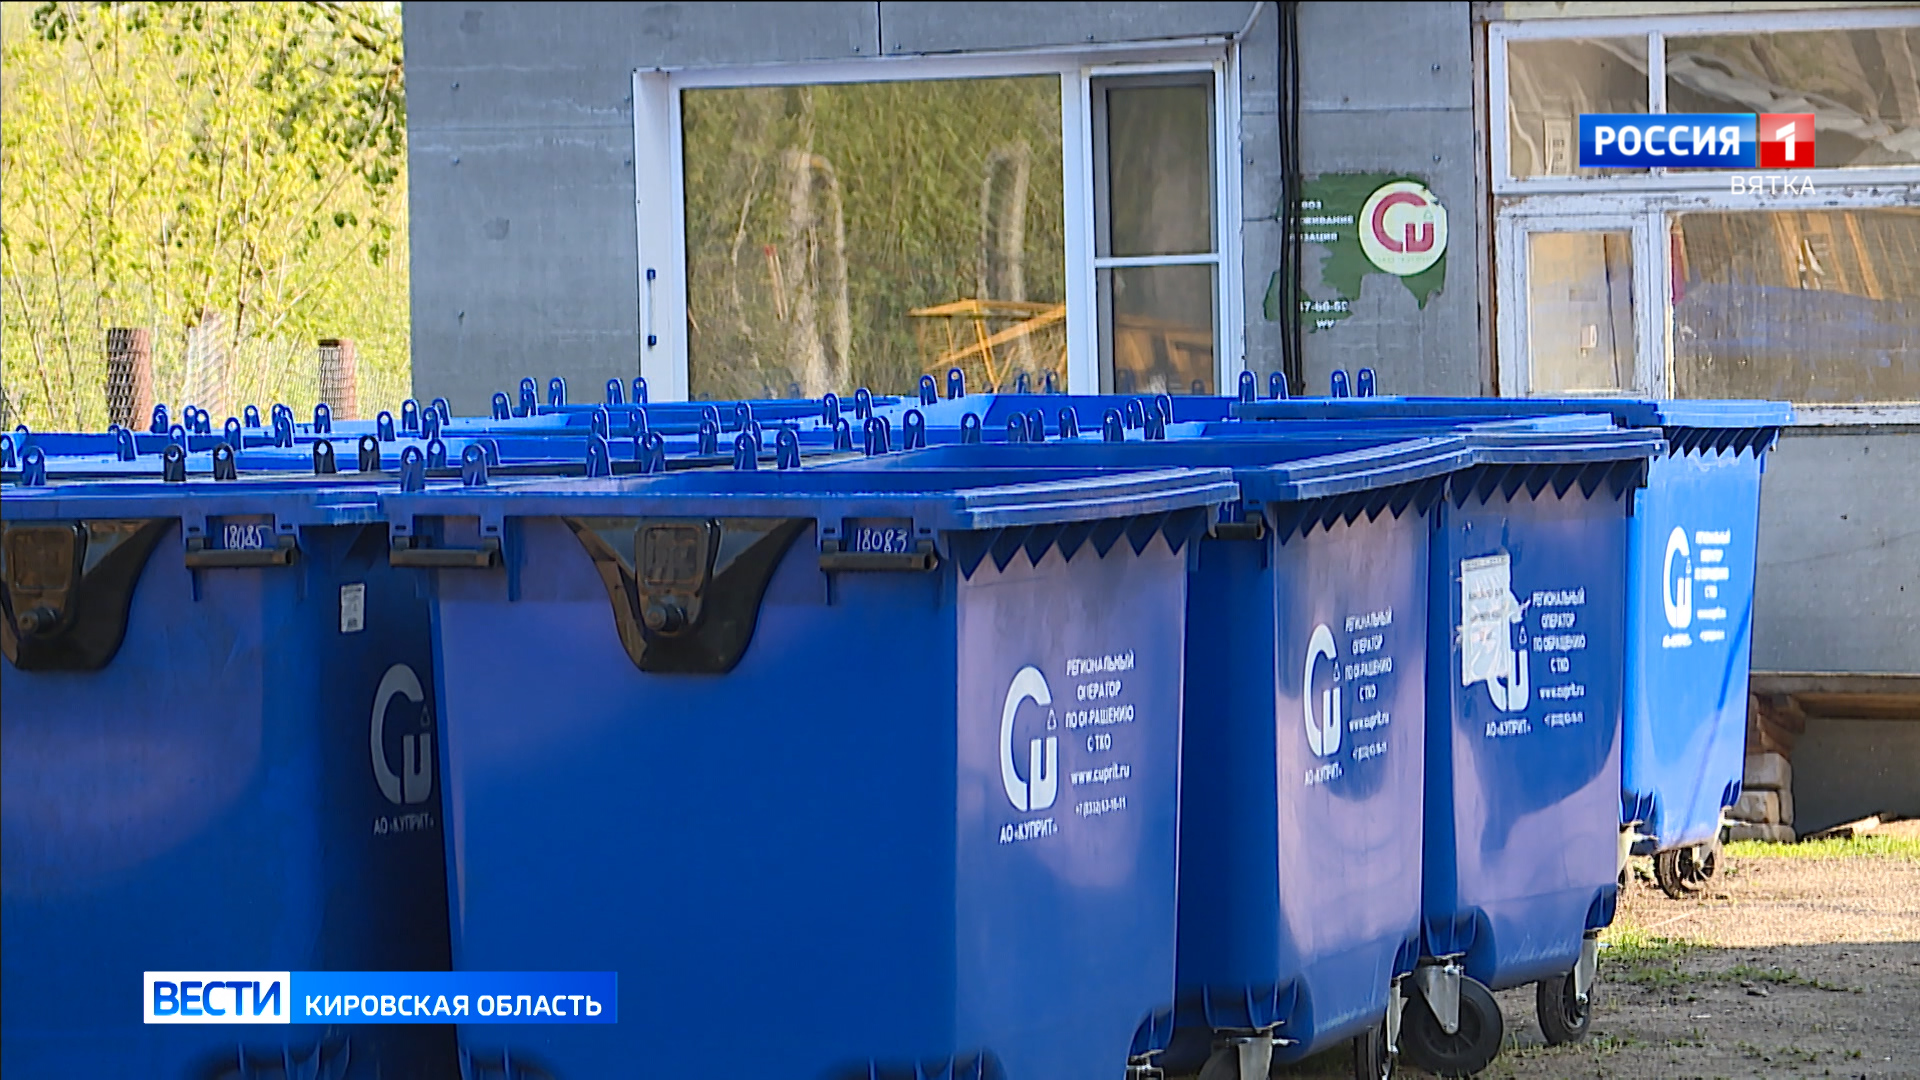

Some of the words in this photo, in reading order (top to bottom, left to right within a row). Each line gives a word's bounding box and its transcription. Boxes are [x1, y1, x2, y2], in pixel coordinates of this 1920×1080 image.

[224, 525, 274, 550] 18085
[857, 528, 908, 552] 18083
[1066, 651, 1135, 676] РЕГИОНАЛЬНЫЙ
[1077, 680, 1122, 701] ОПЕРАТОР
[1065, 712, 1077, 728] ПО
[1095, 734, 1111, 751] ТКО
[1071, 764, 1131, 785] www.cuprit.ru
[1000, 825, 1013, 843] АО
[1014, 818, 1058, 841] «КУПРИТ»
